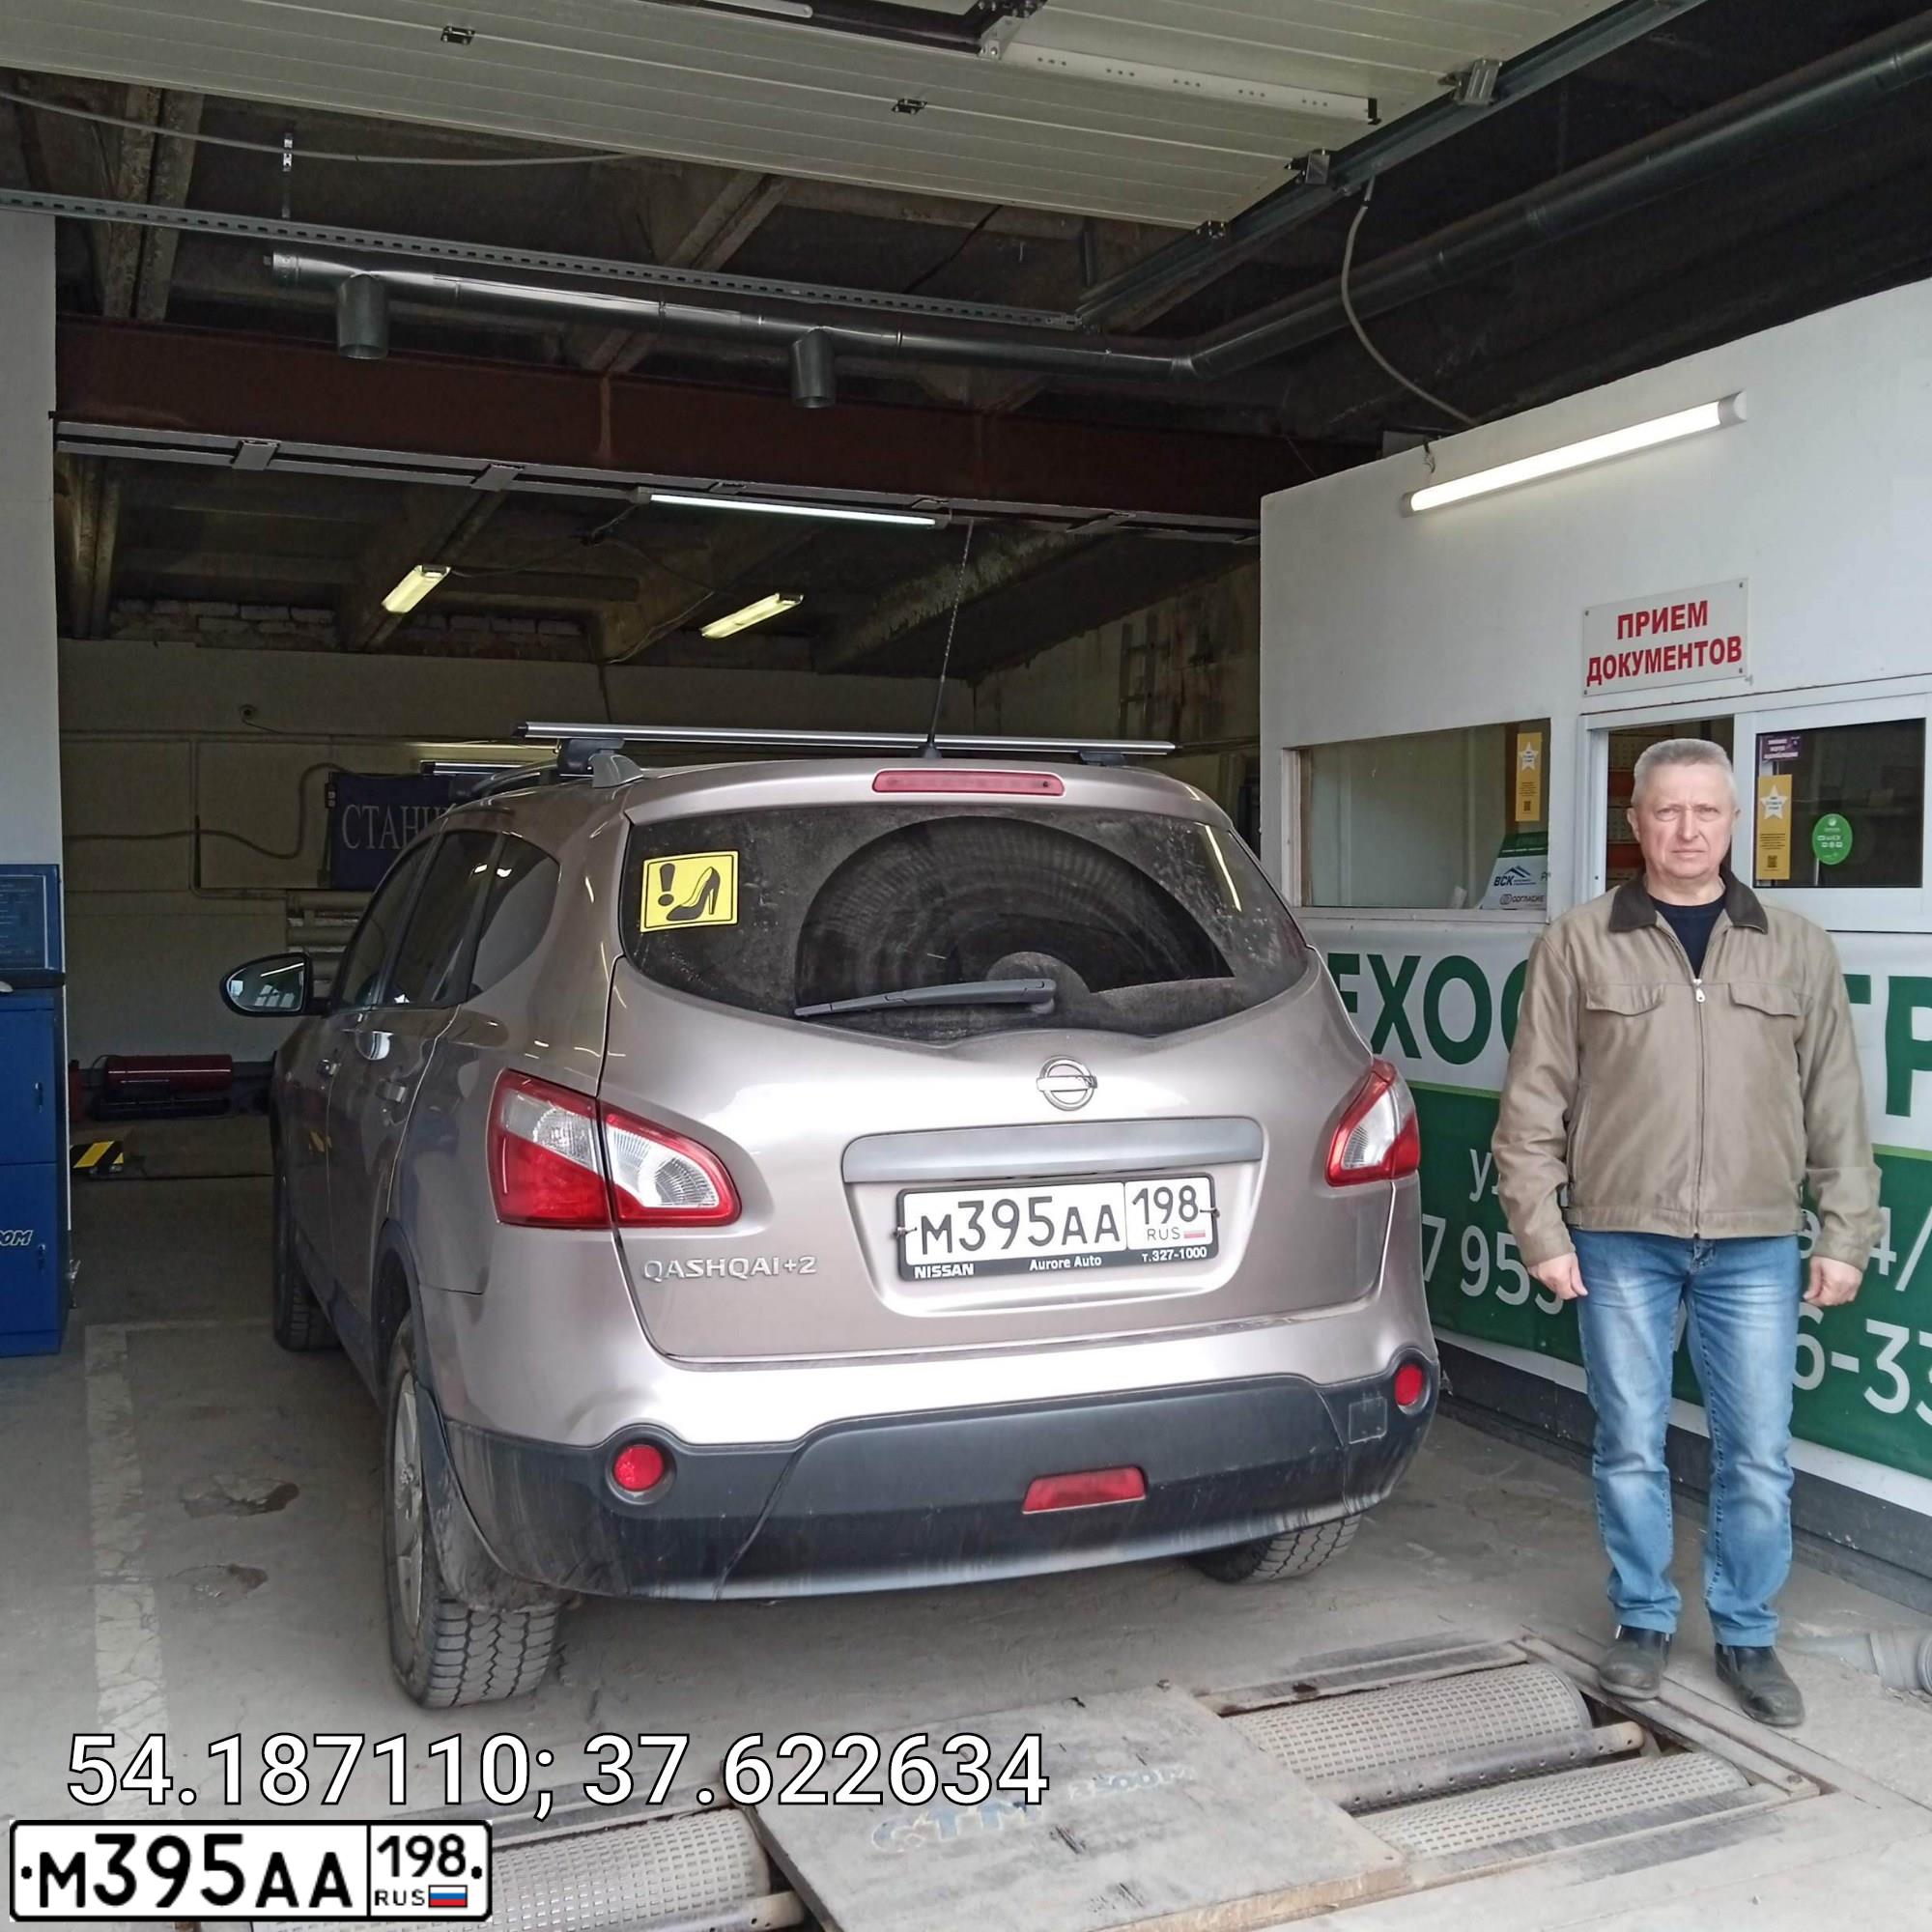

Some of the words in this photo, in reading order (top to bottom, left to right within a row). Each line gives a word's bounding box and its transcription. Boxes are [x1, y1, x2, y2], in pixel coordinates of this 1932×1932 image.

[1617, 600, 1708, 639] ПРИЕМ
[1586, 636, 1742, 687] ДОКУМЕНТОВ
[920, 1195, 1121, 1256] М395АА
[1131, 1184, 1199, 1225] 198
[1147, 1227, 1180, 1240] RUS
[643, 1256, 817, 1283] QASHQAI+2
[914, 1264, 974, 1278] NISSAN
[1029, 1259, 1071, 1271] Aurore
[1074, 1256, 1102, 1267] Auto
